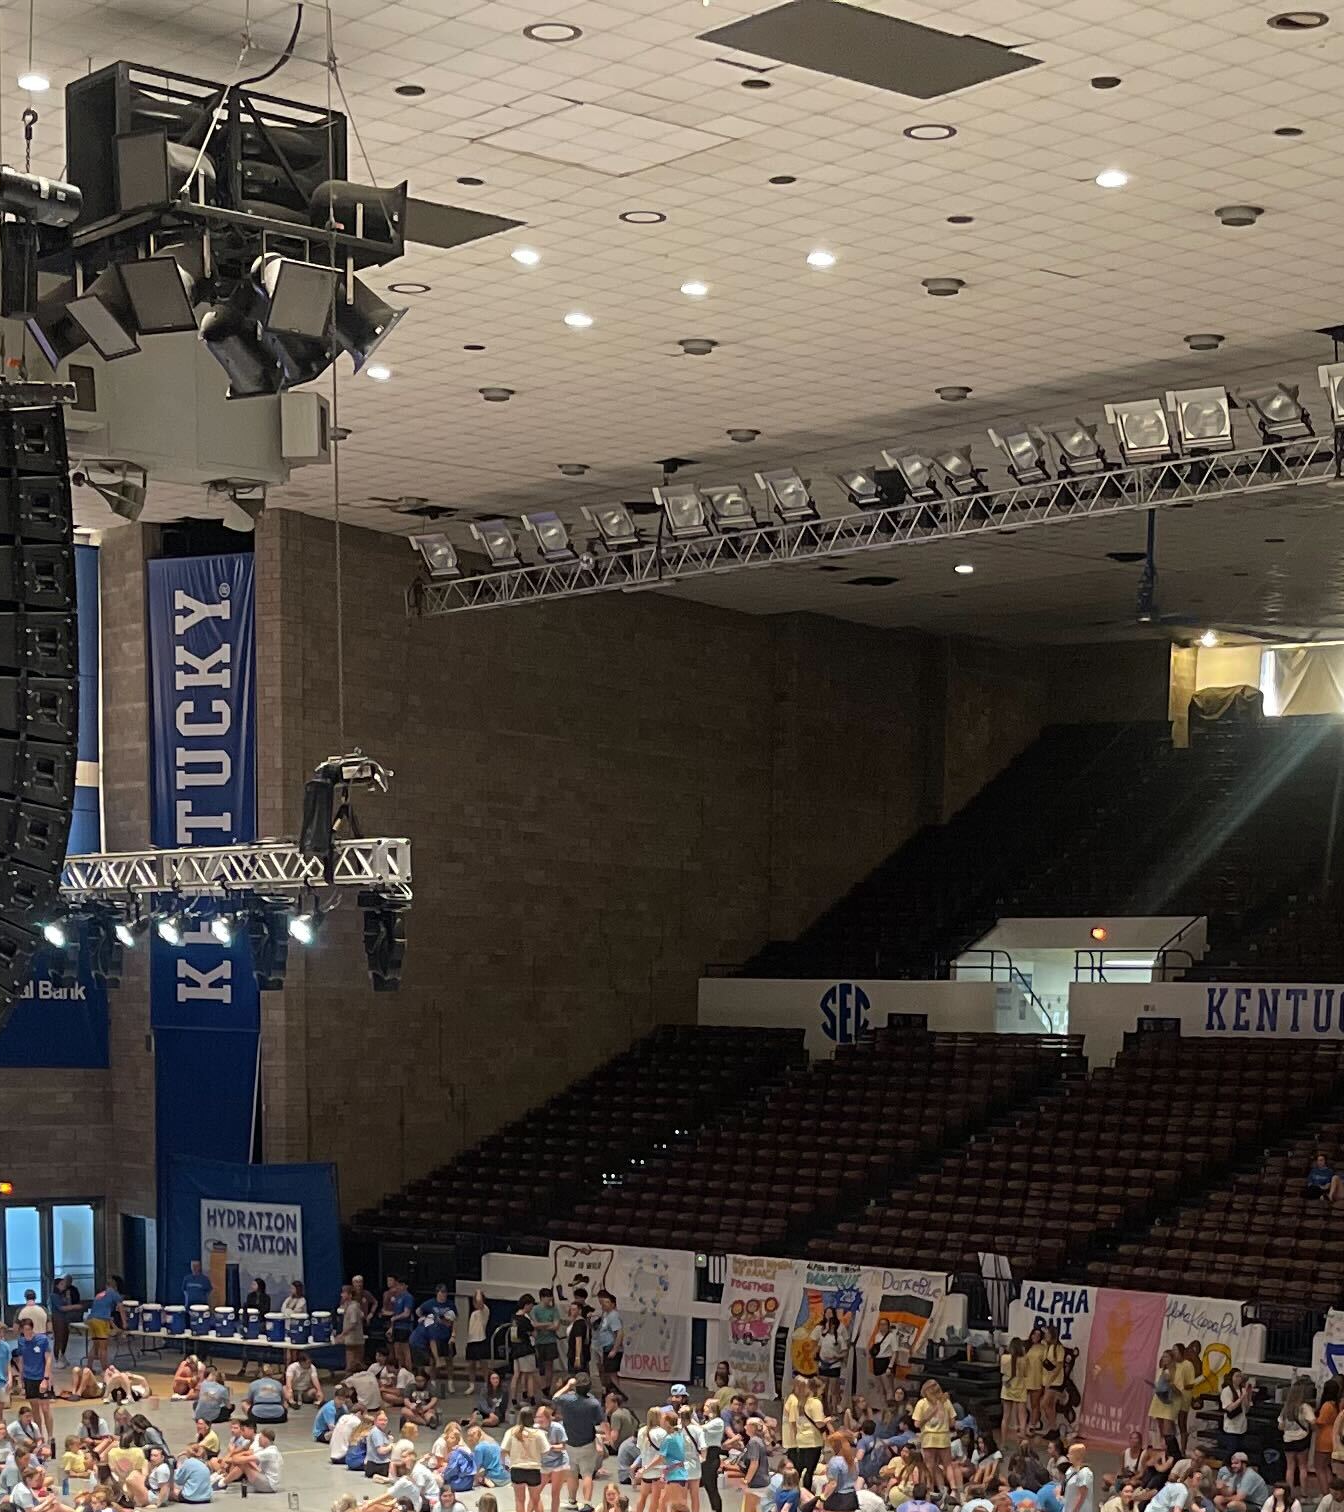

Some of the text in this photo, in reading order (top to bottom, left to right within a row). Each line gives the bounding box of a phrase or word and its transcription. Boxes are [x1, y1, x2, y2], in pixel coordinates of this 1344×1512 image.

[37, 980, 86, 1001] Bank
[819, 982, 870, 1043] SEC
[206, 1207, 297, 1233] HYDRATION
[237, 1232, 297, 1257] STATION
[730, 1278, 775, 1293] TOGETHER
[1023, 1286, 1089, 1315] ALPHA
[624, 1352, 672, 1373] MORALE
